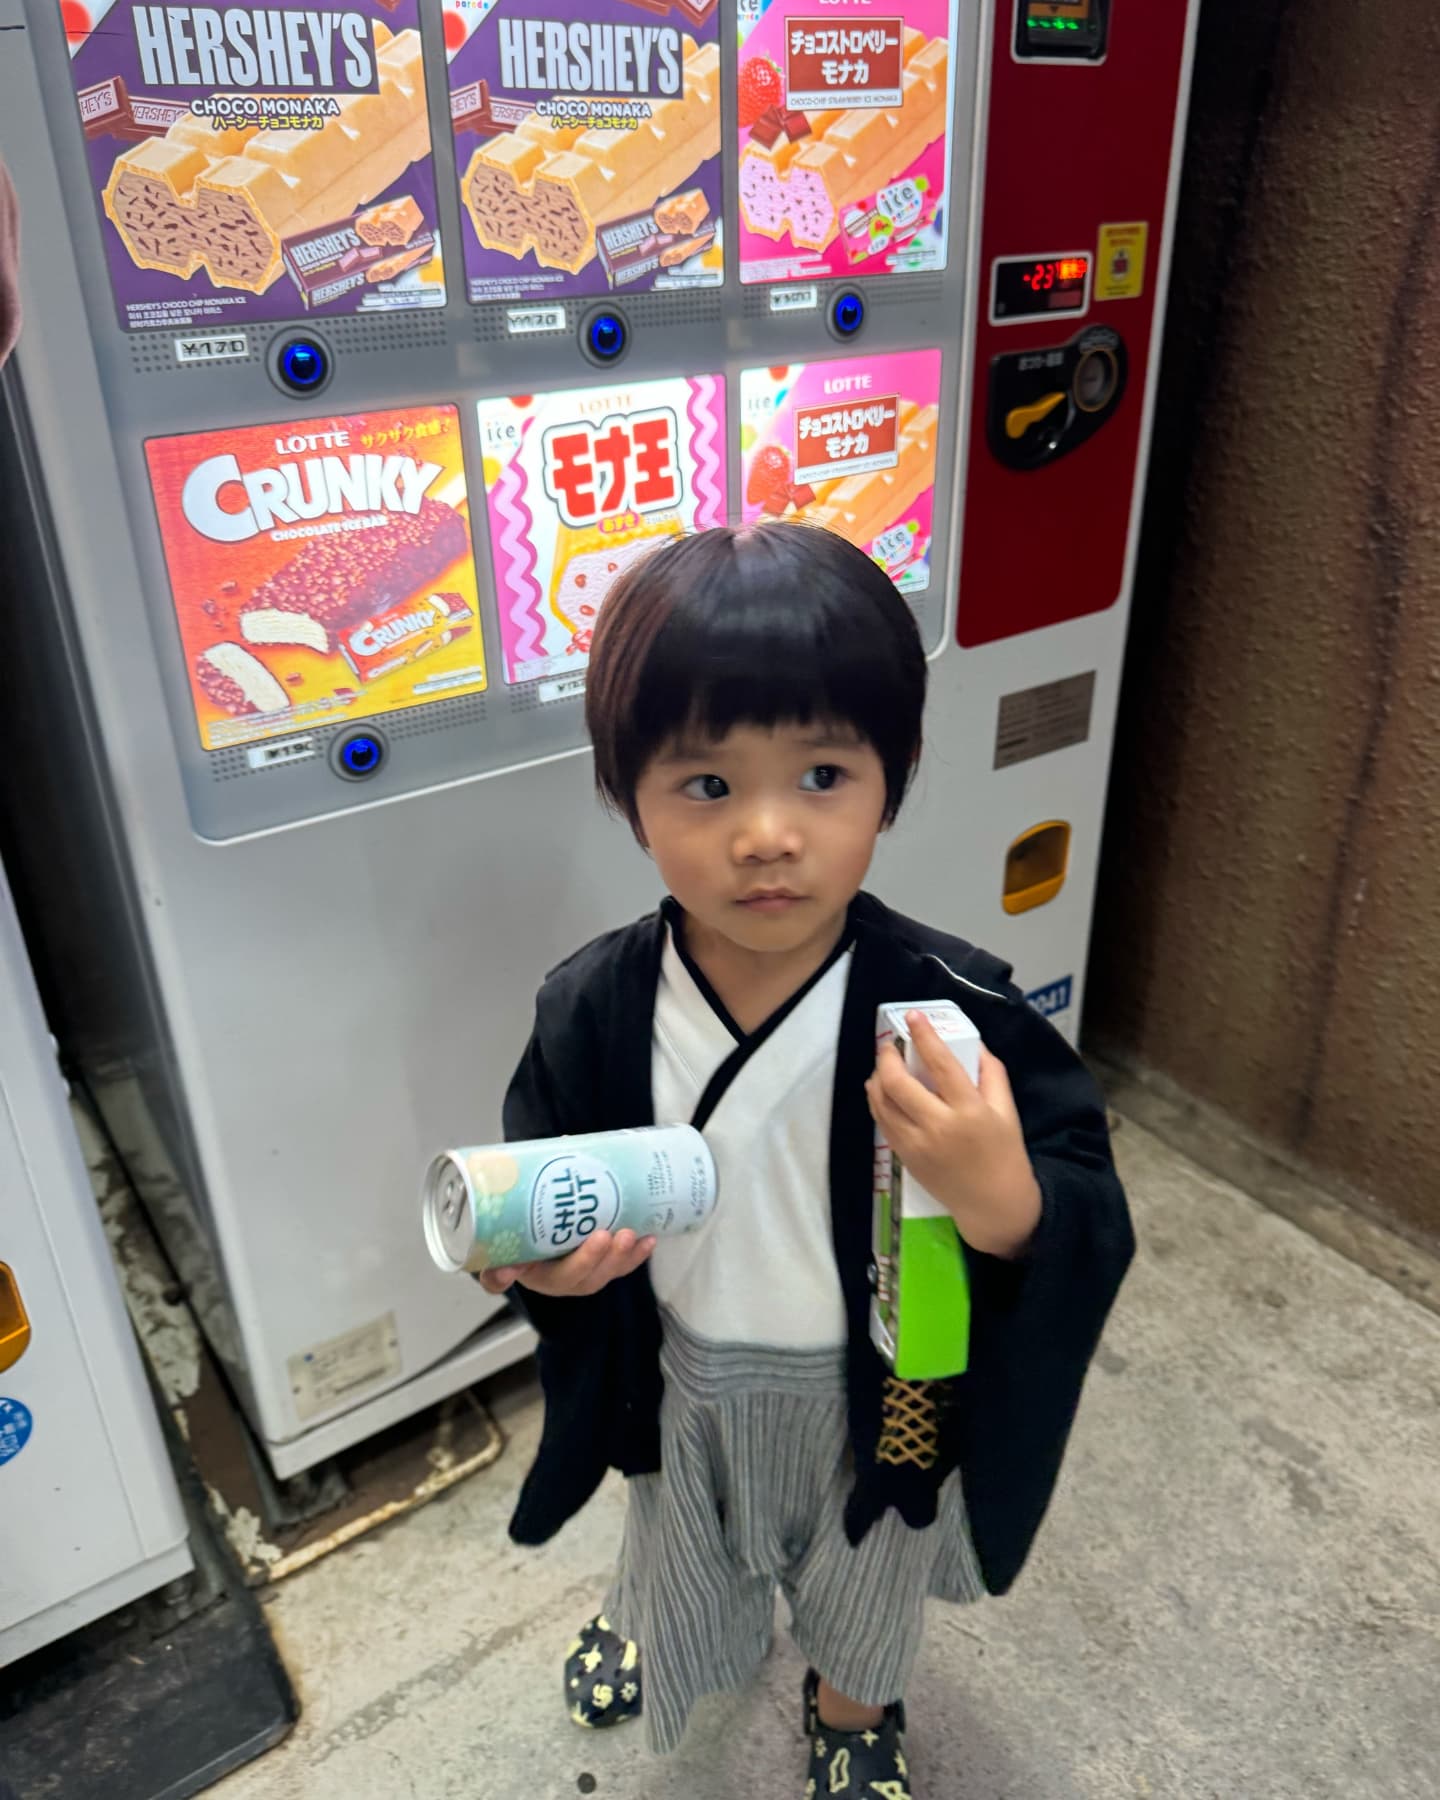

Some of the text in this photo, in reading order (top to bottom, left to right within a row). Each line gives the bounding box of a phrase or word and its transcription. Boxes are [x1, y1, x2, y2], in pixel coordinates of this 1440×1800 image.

[132, 6, 373, 88] HERSHEY'S
[790, 30, 899, 55] チョコストロベリー
[498, 18, 680, 95] HERSHEY'S
[821, 60, 870, 84] モナカ
[190, 99, 340, 116] CHOCO MONAKA
[535, 101, 653, 119] CHOCO MONAKA
[213, 116, 323, 129] ハーシーチョコモナカ
[551, 117, 639, 129] ハーシーチョコモナカ
[602, 215, 659, 251] HERSHEY'S
[290, 227, 361, 266] HERSHEY'S
[183, 339, 246, 354] ¥170
[824, 374, 873, 394] LOTTE
[579, 395, 633, 415] LOTTE
[799, 403, 896, 440] チョコストロベリー
[274, 430, 350, 455] LOTTE
[825, 432, 870, 458] モナカ
[551, 418, 676, 518] モナ王
[181, 453, 446, 543] CRUNKY
[350, 609, 436, 657] CRUNKY
[550, 1166, 579, 1247] CHILL
[574, 1173, 599, 1237] OUT
